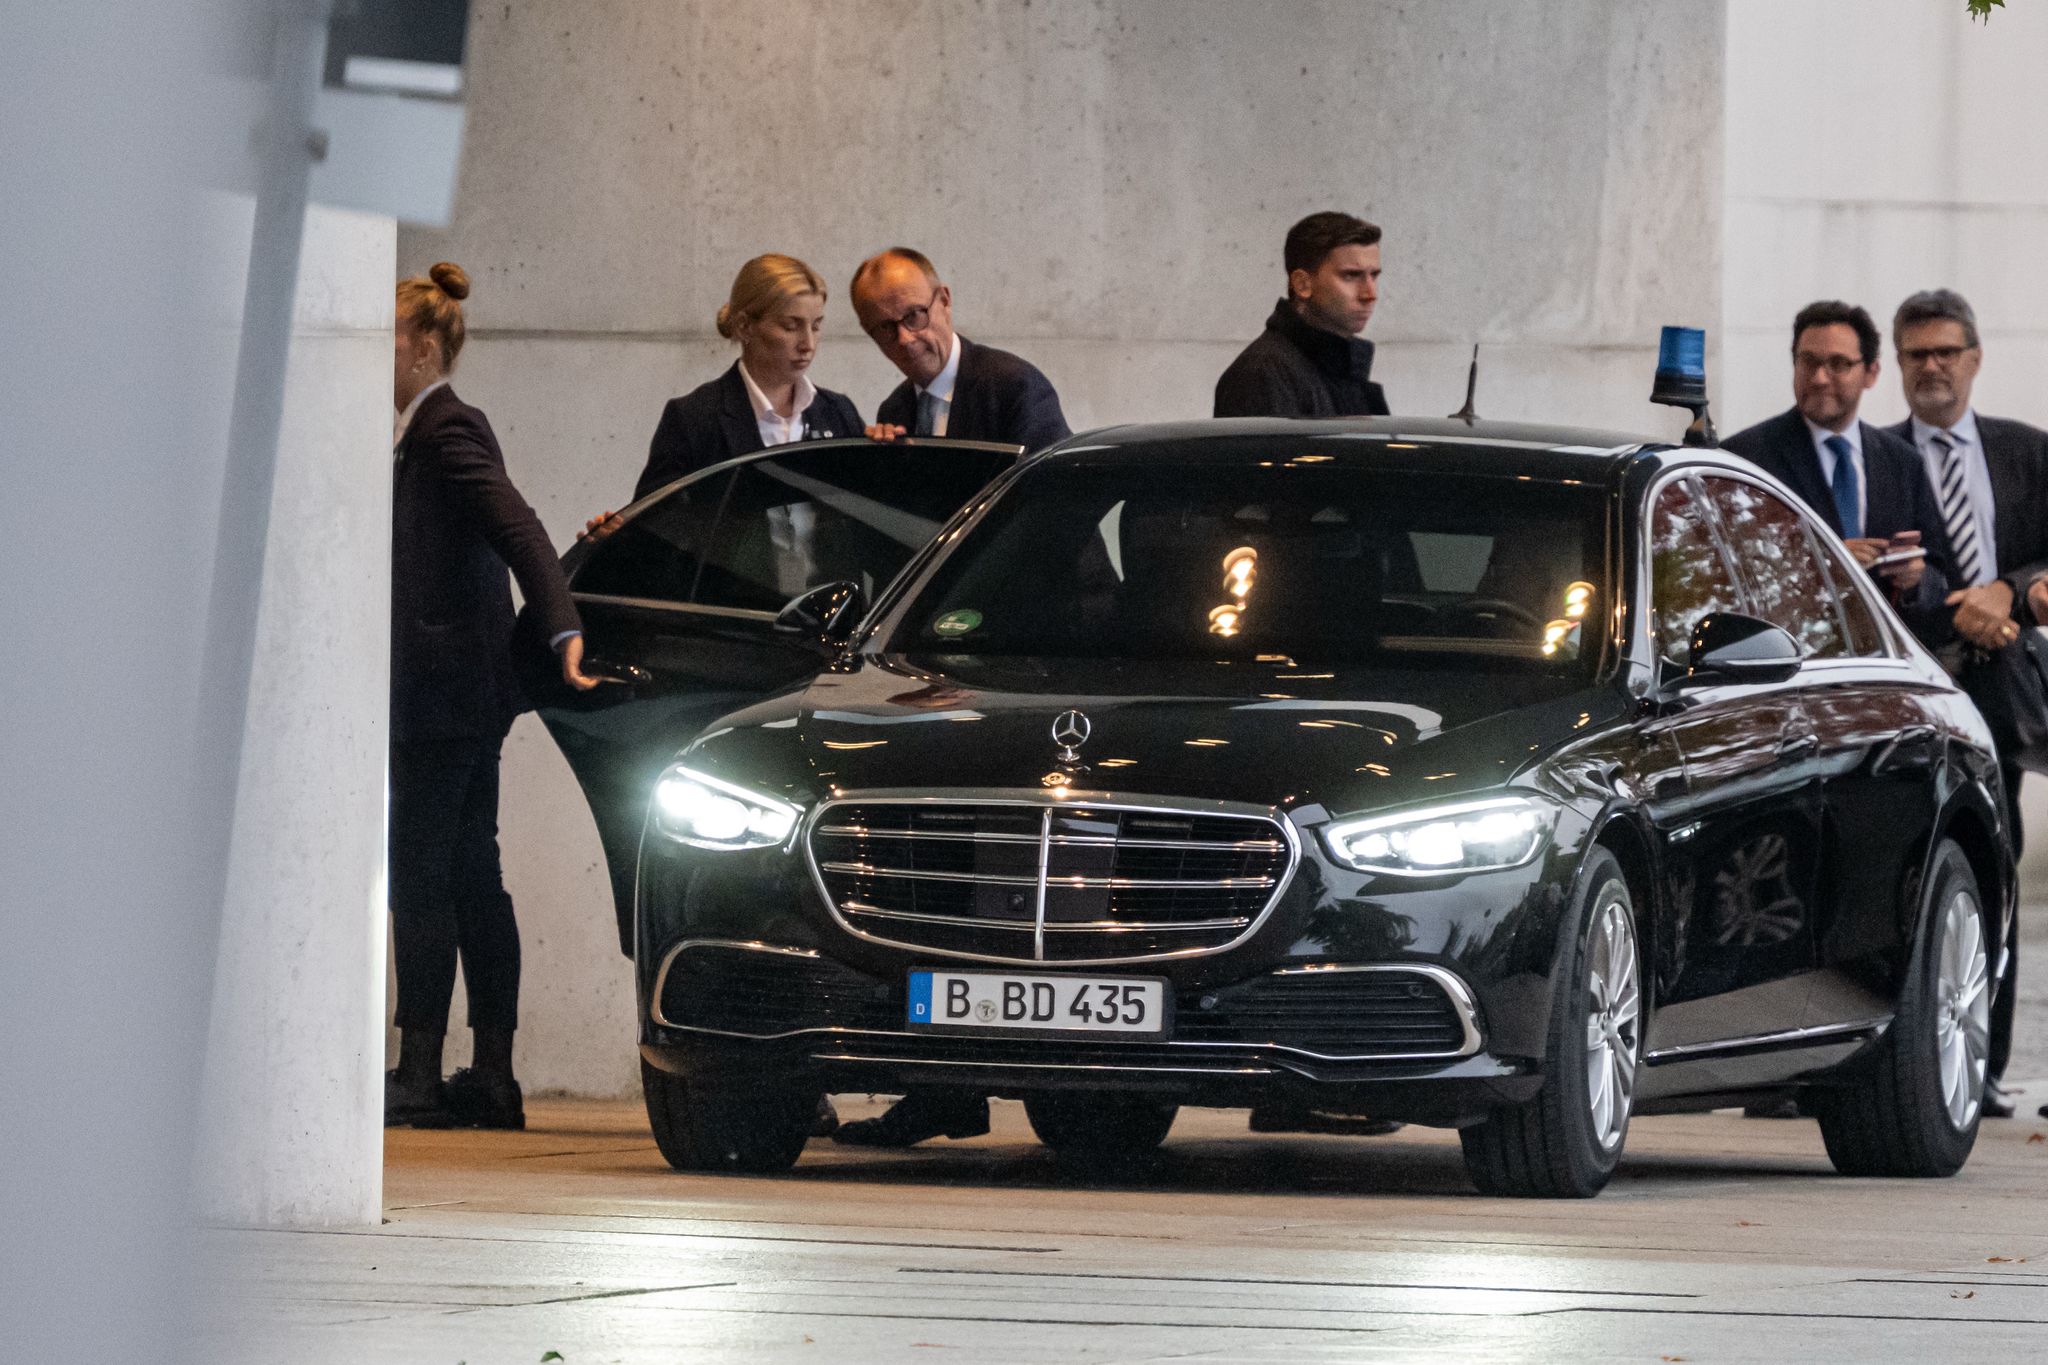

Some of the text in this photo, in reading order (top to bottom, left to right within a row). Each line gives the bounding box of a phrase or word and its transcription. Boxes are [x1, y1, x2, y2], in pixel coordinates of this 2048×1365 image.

[915, 1003, 925, 1015] D
[946, 979, 1147, 1025] B BD 435
